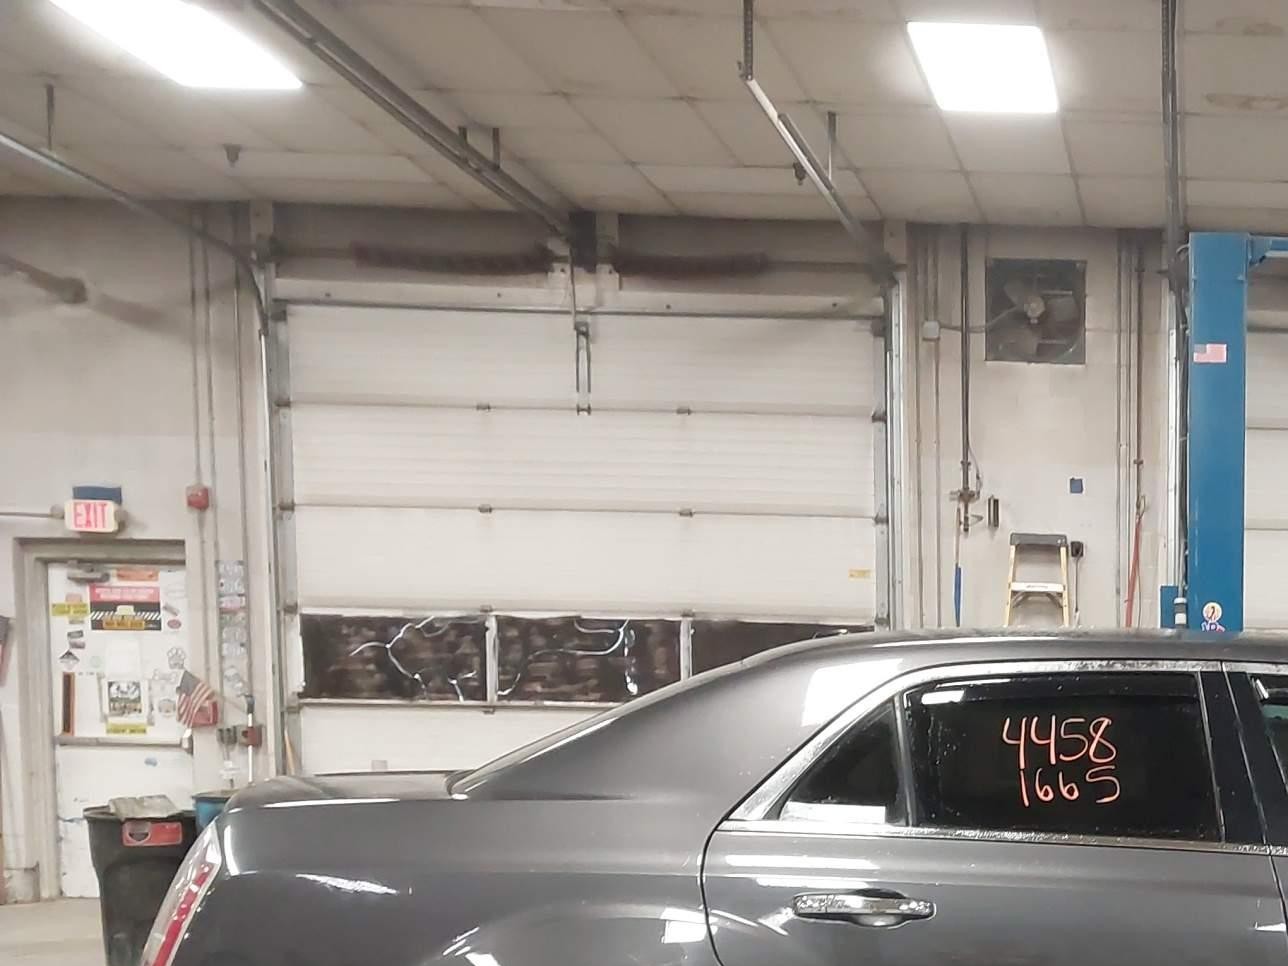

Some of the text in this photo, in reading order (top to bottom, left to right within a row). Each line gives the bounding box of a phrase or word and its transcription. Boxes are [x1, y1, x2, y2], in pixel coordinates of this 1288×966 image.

[73, 502, 108, 528] EXIT
[1001, 714, 1118, 770] 4458
[1019, 765, 1121, 808] 1665
